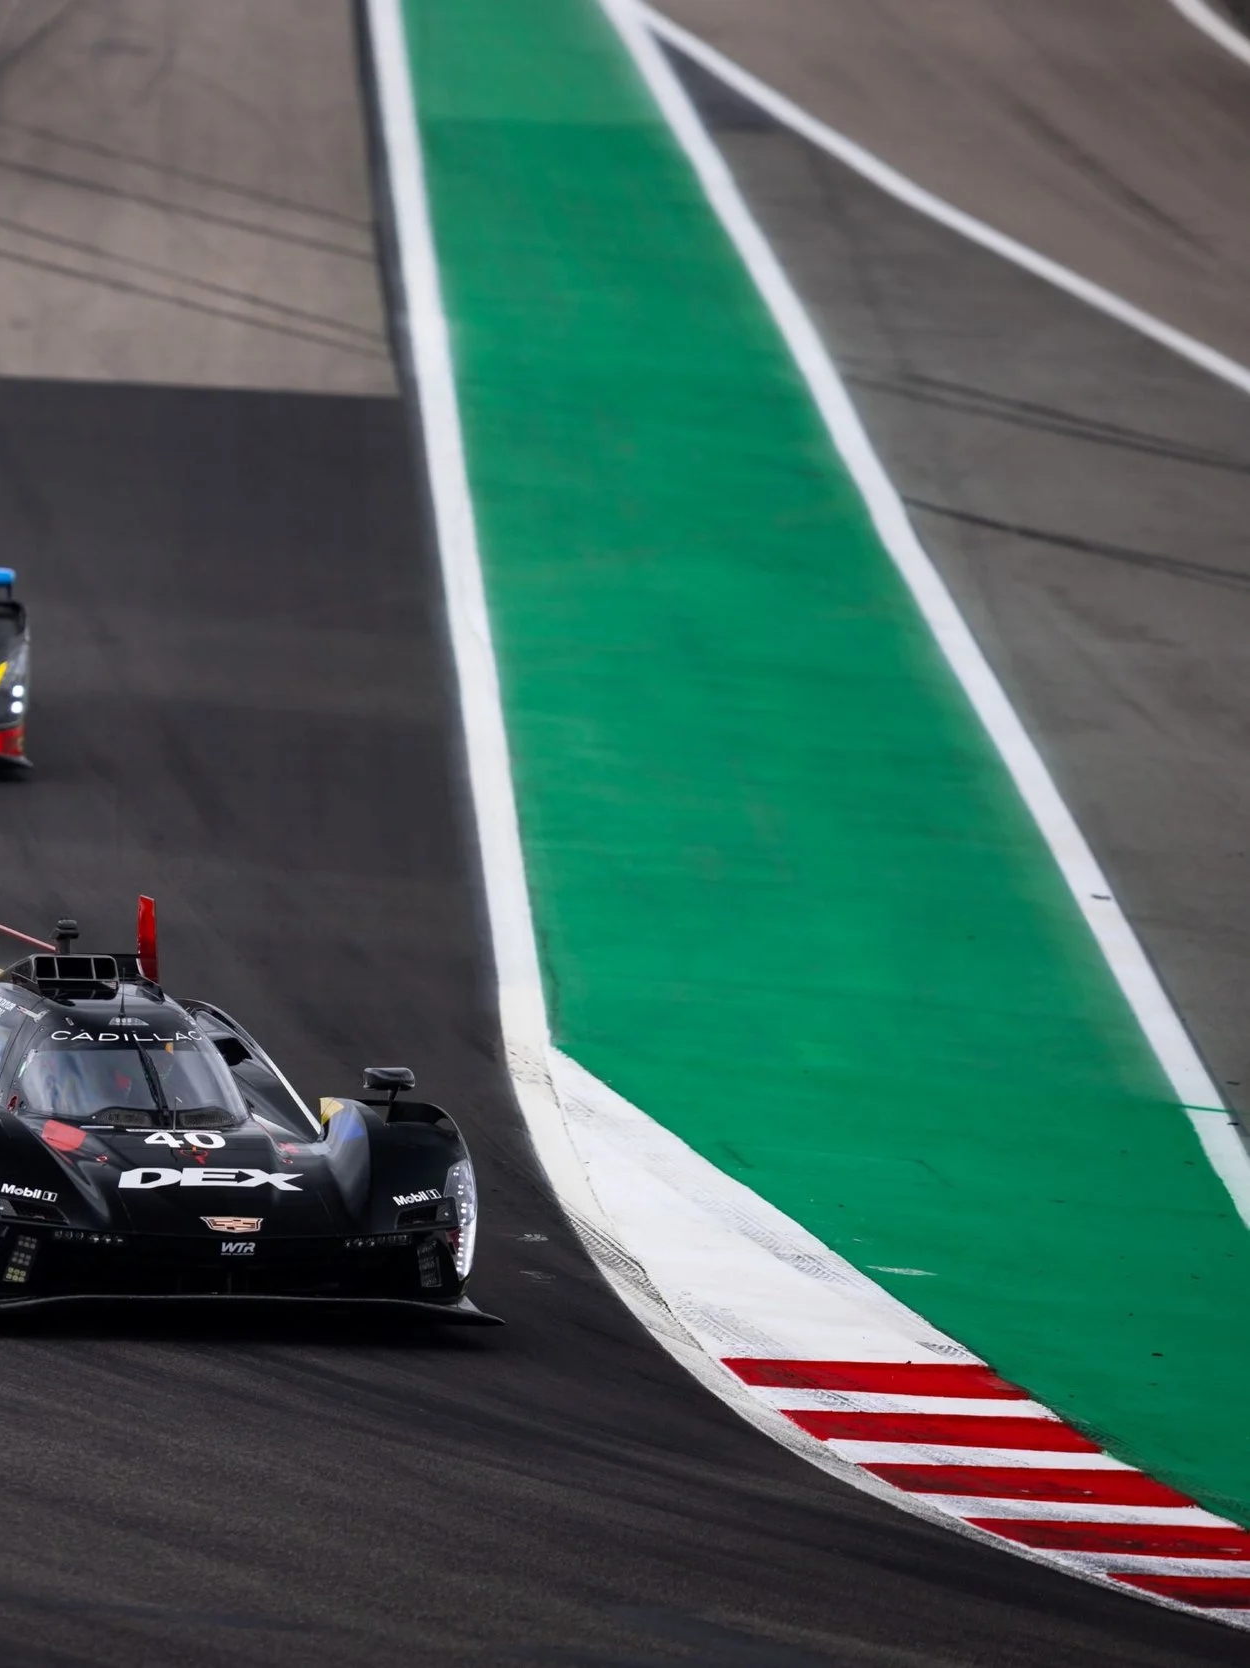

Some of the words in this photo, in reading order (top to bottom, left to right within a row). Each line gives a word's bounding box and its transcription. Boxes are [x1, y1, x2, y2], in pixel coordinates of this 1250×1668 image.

[51, 1031, 203, 1042] CADILLAC
[144, 1132, 227, 1149] 40
[118, 1167, 304, 1191] DEX
[0, 1183, 42, 1199] Mobil
[393, 1191, 429, 1206] Mobil
[221, 1241, 256, 1253] WTR
